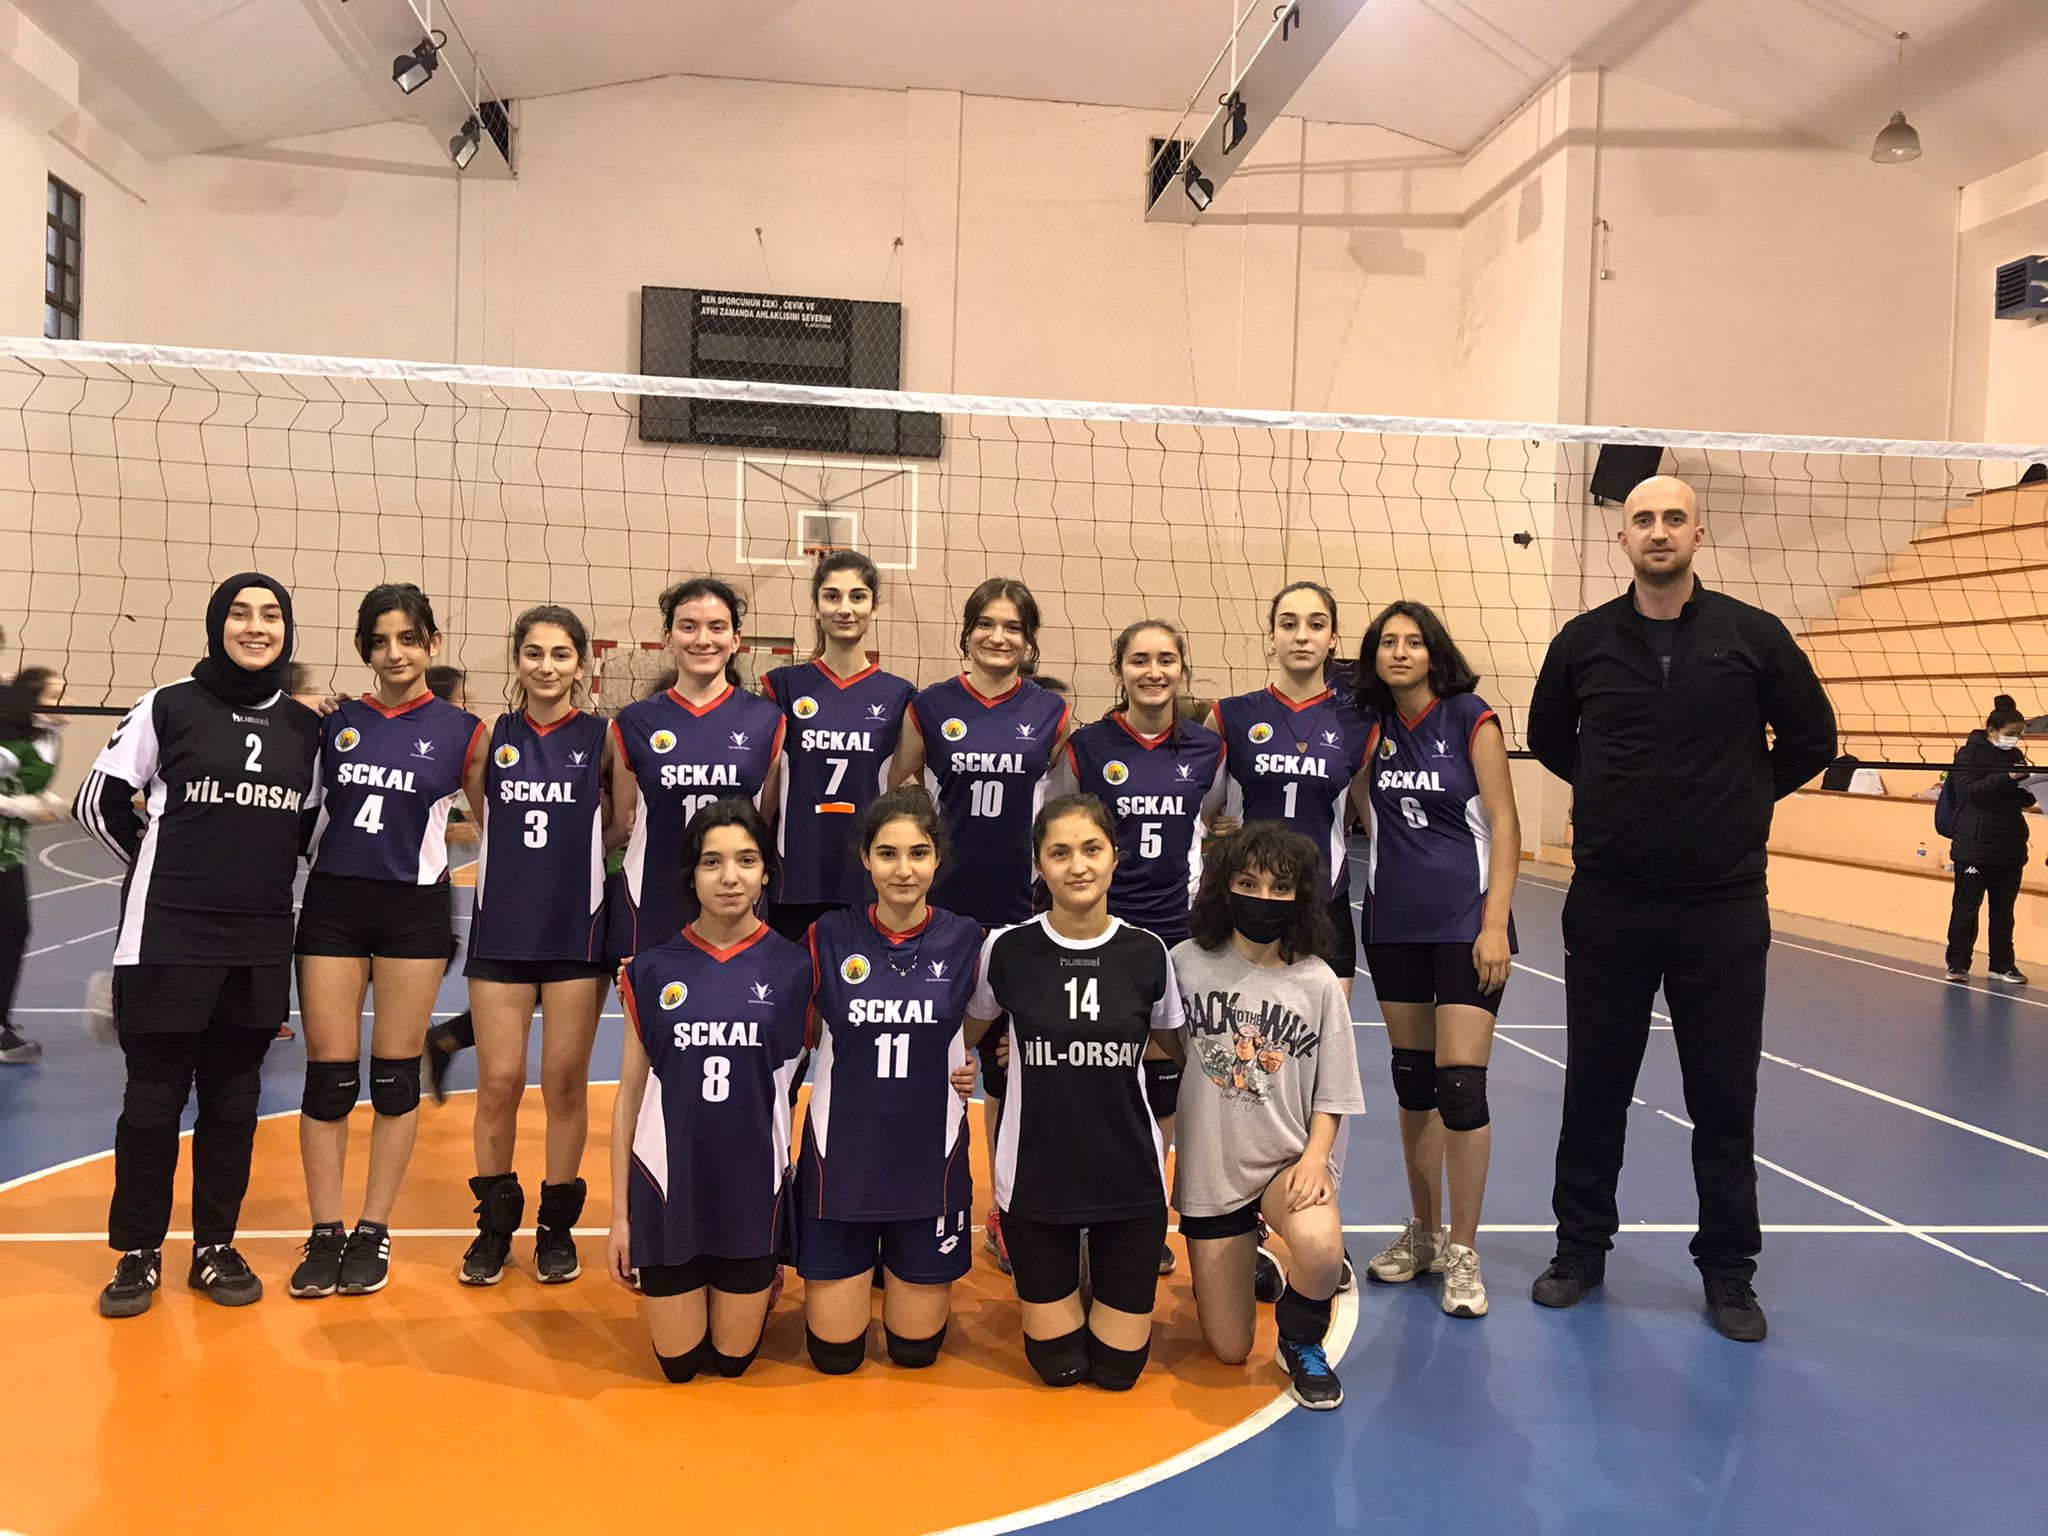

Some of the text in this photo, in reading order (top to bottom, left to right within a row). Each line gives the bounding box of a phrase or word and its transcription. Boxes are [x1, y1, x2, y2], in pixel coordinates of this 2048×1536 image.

[701, 295, 716, 304] BEN
[717, 296, 761, 307] SPORCUNUN
[805, 302, 815, 311] VE
[701, 306, 718, 315] AYNI
[719, 308, 754, 318] ZAMANDA
[245, 733, 262, 772] 2
[801, 729, 874, 752] ŞCKAL
[337, 763, 417, 793] ŞCKAL
[660, 764, 741, 789] ŞCKAL
[825, 758, 849, 795] 7
[950, 752, 1026, 775] ŞCKAL
[1254, 753, 1330, 779] ŞCKAL
[500, 780, 576, 803] ŞCKAL
[1377, 770, 1446, 792] ŞCKAL
[353, 794, 384, 834] 4
[970, 780, 1004, 818] 10
[1116, 795, 1186, 819] ŞCKAL
[1283, 782, 1298, 818] 1
[1400, 796, 1429, 829] 6
[523, 810, 549, 849] 3
[1139, 822, 1163, 859] 5
[1059, 956, 1101, 967] hummel
[847, 998, 939, 1027] ŞCKAL
[1064, 977, 1101, 1021] 14
[673, 1021, 763, 1051] ŞCKAL
[874, 1033, 910, 1078] 11
[702, 1055, 731, 1103] 8
